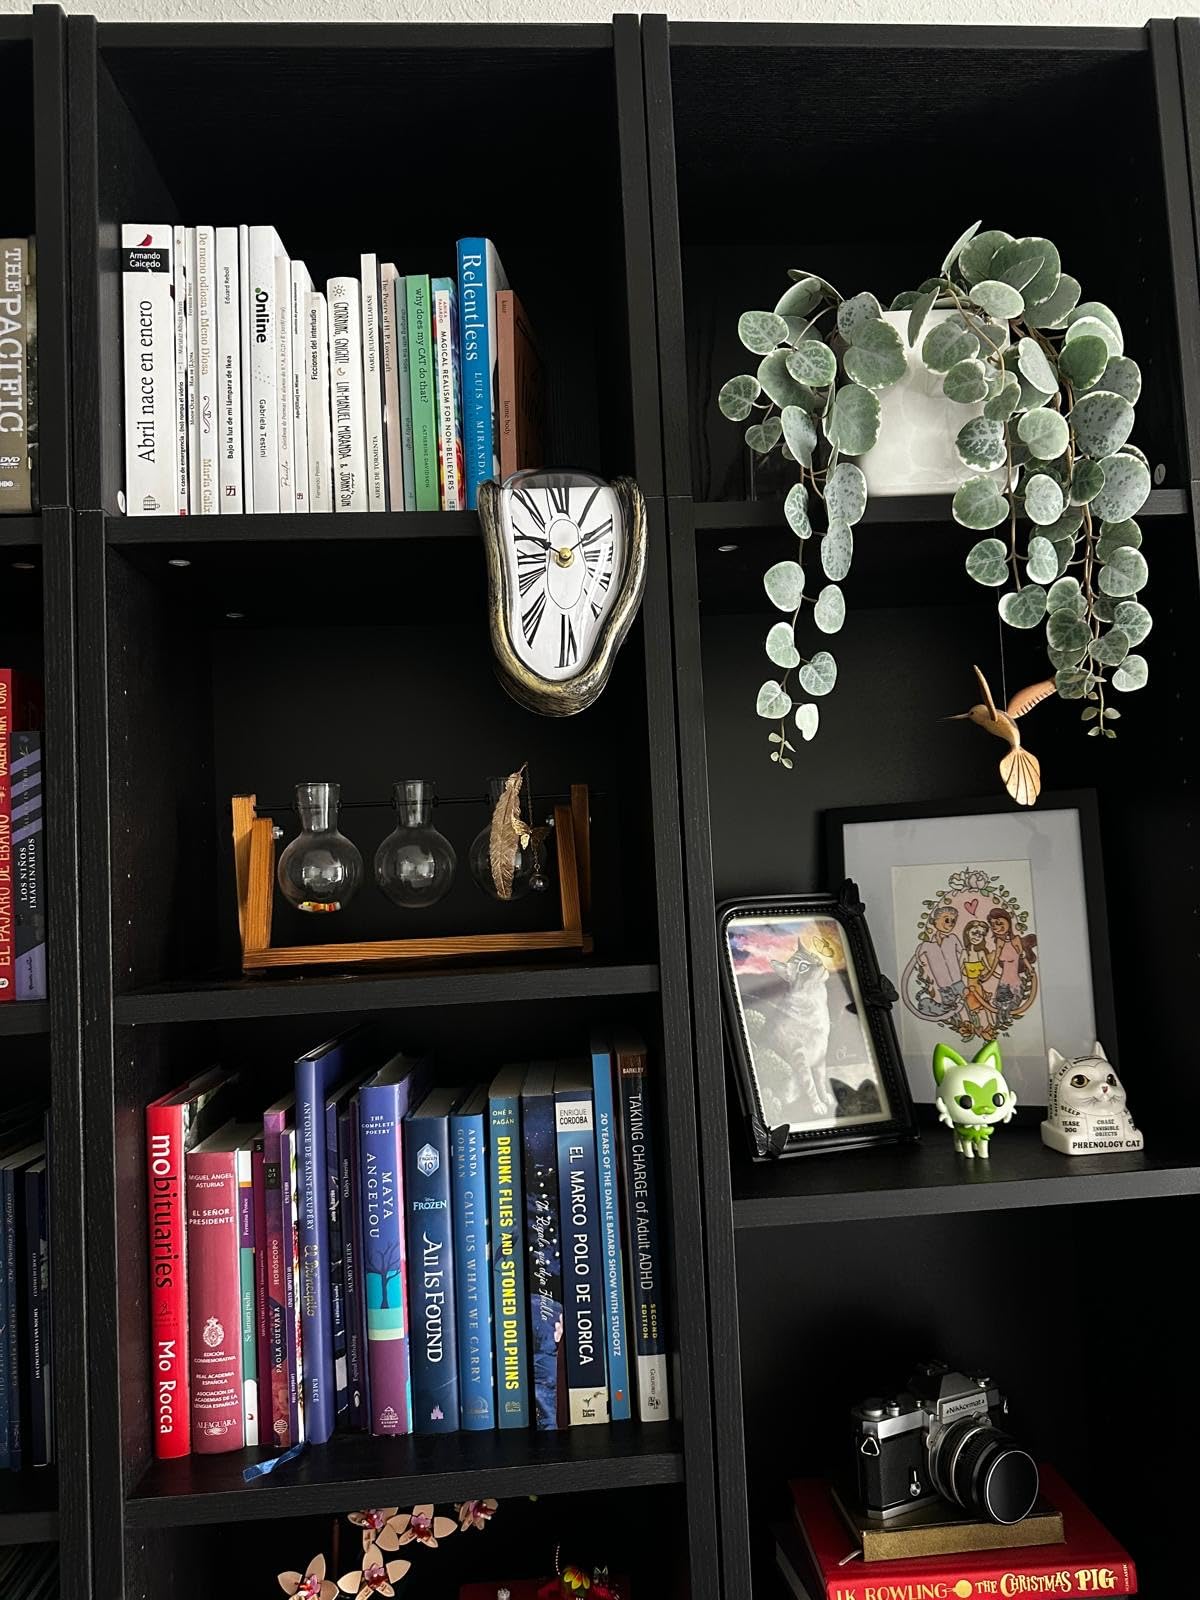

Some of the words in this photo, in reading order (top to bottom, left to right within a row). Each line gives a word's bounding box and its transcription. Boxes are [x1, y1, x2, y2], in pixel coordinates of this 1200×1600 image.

[199, 232, 208, 246] De
[129, 251, 161, 260] Armando
[129, 259, 161, 268] Caicedo
[5, 247, 22, 292] THE
[414, 288, 423, 307] why
[463, 253, 485, 361] Relentless
[139, 300, 153, 348] enero
[255, 290, 269, 344] Online
[416, 308, 424, 330] does
[335, 338, 350, 364] GNIGHT!
[415, 332, 423, 346] my
[440, 331, 448, 366] MAGICAL
[0, 294, 24, 433] PACIFIC
[140, 353, 154, 372] en
[310, 351, 318, 380] Ficciones
[418, 347, 426, 365] CAT
[226, 370, 232, 379] de
[419, 367, 427, 379] do
[442, 369, 450, 403] REALISM
[474, 372, 484, 399] LUIS
[140, 377, 154, 416] nace
[225, 379, 234, 406] lámpara
[336, 382, 352, 423] LIN-MANUEL
[420, 381, 429, 403] that?
[227, 407, 233, 416] mi
[227, 417, 233, 425] de
[259, 399, 267, 430] Gabriela
[443, 406, 451, 422] FOR
[477, 404, 484, 415] A.
[503, 419, 511, 436] body
[136, 420, 156, 465] Abril
[227, 444, 235, 459] Bajo
[259, 432, 267, 458] Testini
[337, 425, 352, 460] MIRANDA
[476, 420, 486, 476] MIRANDA
[445, 424, 454, 490] NON-BELIEVERS
[339, 472, 351, 493] JONNY
[340, 493, 352, 507] SUN
[17, 847, 27, 880] NIÑOS
[28, 838, 37, 909] IMAGINARIOS
[20, 882, 28, 901] LOS
[1058, 1066, 1069, 1076] EAT
[303, 1102, 312, 1143] ANTOINE
[559, 1108, 588, 1117] ENRIQUE
[559, 1116, 589, 1126] CORDOBA
[600, 1112, 608, 1125] 20
[628, 1093, 644, 1141] TAKING
[1060, 1105, 1081, 1116] SLEEP
[361, 1121, 395, 1129] COMPLETE
[365, 1128, 391, 1136] POETRY
[304, 1146, 313, 1158] DE
[457, 1129, 466, 1178] GORMAN
[468, 1128, 477, 1177] AMANDA
[601, 1126, 610, 1154] YEARS
[1072, 1140, 1123, 1149] PHRENOLOGY
[1125, 1139, 1141, 1147] CAT
[424, 1161, 434, 1171] 10
[497, 1136, 512, 1184] DRUNK
[569, 1146, 584, 1163] EL
[603, 1156, 611, 1169] OF
[604, 1170, 612, 1187] THE
[632, 1144, 648, 1198] CHARGE
[305, 1160, 315, 1231] SAINT-EXUPÉRY
[366, 1153, 380, 1238] ANGELOU
[381, 1171, 394, 1219] MAYA
[413, 1200, 448, 1211] FROZEN
[498, 1189, 513, 1227] FLIES
[570, 1170, 587, 1226] MARCO
[605, 1189, 613, 1209] DAN
[635, 1201, 648, 1214] of
[152, 1135, 179, 1289] mobituaries
[189, 1216, 235, 1225] PRESIDENTE
[202, 1208, 230, 1217] SEÑOR
[464, 1191, 475, 1228] CALL
[605, 1211, 614, 1221] LE
[465, 1234, 476, 1252] US
[501, 1232, 513, 1255] AND
[531, 1215, 551, 1247] Regalo
[606, 1222, 616, 1257] BATARD
[636, 1217, 651, 1250] Adult
[272, 1239, 280, 1285] HORÓSCOPO
[573, 1233, 590, 1275] POLO
[466, 1259, 478, 1301] WHAT
[533, 1267, 553, 1285] deja
[608, 1258, 618, 1288] SHOW
[638, 1252, 654, 1290] ADHD
[501, 1260, 517, 1315] STONED
[575, 1283, 591, 1303] DE
[538, 1288, 554, 1321] Huella
[610, 1289, 619, 1314] WITH
[274, 1307, 282, 1345] GUEVARA
[468, 1308, 479, 1329] WE
[641, 1304, 649, 1339] EDITION
[650, 1303, 658, 1339] SECOND
[576, 1310, 594, 1365] LORICA
[611, 1315, 622, 1356] STUGOTZ
[158, 1340, 176, 1371] Mo
[275, 1346, 283, 1374] PAOLA
[469, 1336, 482, 1384] CARRY
[503, 1320, 520, 1390] DOLPHINS
[202, 1378, 228, 1386] ESPAÑOLA
[207, 1371, 235, 1379] ACADEMIA
[159, 1380, 177, 1434] Rocca
[212, 1400, 239, 1409] ESPAÑOLA
[196, 1418, 238, 1429] ALFAGUARA
[864, 1582, 948, 1600] ROWLING
[975, 1579, 998, 1594] THE
[999, 1571, 1073, 1596] CHRISTMAS
[1074, 1567, 1119, 1591] PIG
